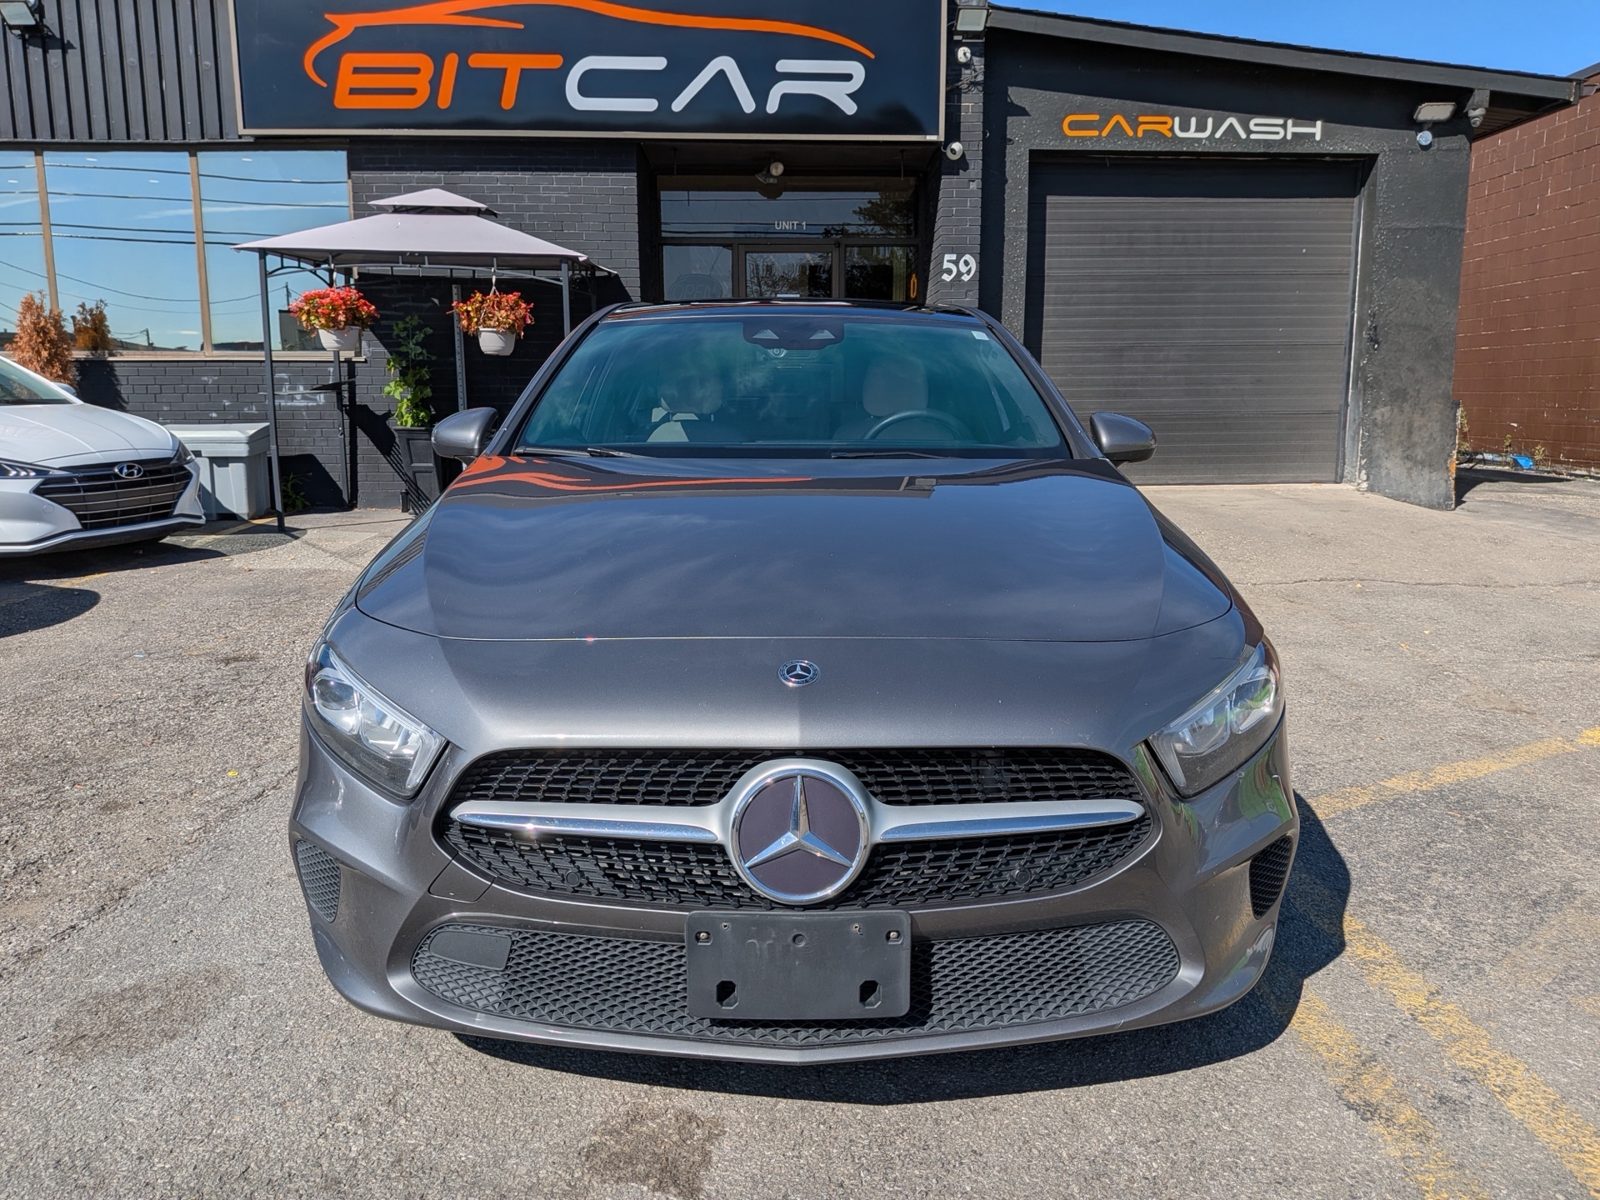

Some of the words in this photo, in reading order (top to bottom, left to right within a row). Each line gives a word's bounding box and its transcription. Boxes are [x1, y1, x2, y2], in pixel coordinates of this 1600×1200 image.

[333, 52, 866, 116] BITCAR
[1061, 113, 1322, 142] CARWASH
[774, 220, 799, 230] UNIT
[801, 220, 807, 230] 1
[941, 253, 977, 282] 59
